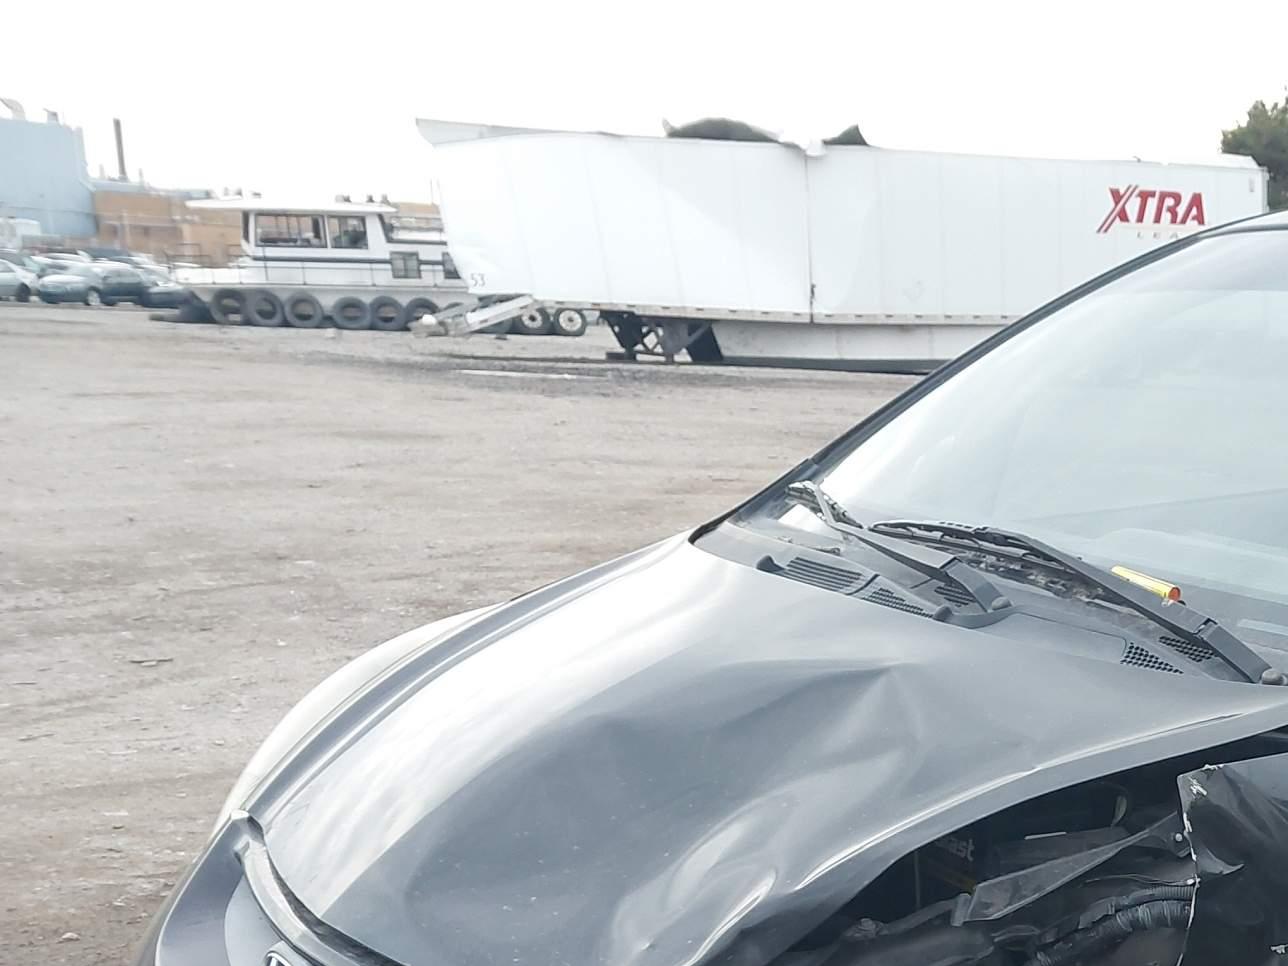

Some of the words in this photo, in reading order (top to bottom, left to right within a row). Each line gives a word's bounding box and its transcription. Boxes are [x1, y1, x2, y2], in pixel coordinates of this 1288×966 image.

[1097, 184, 1206, 233] XTRA
[1137, 231, 1179, 240] LEA
[470, 272, 486, 288] 53
